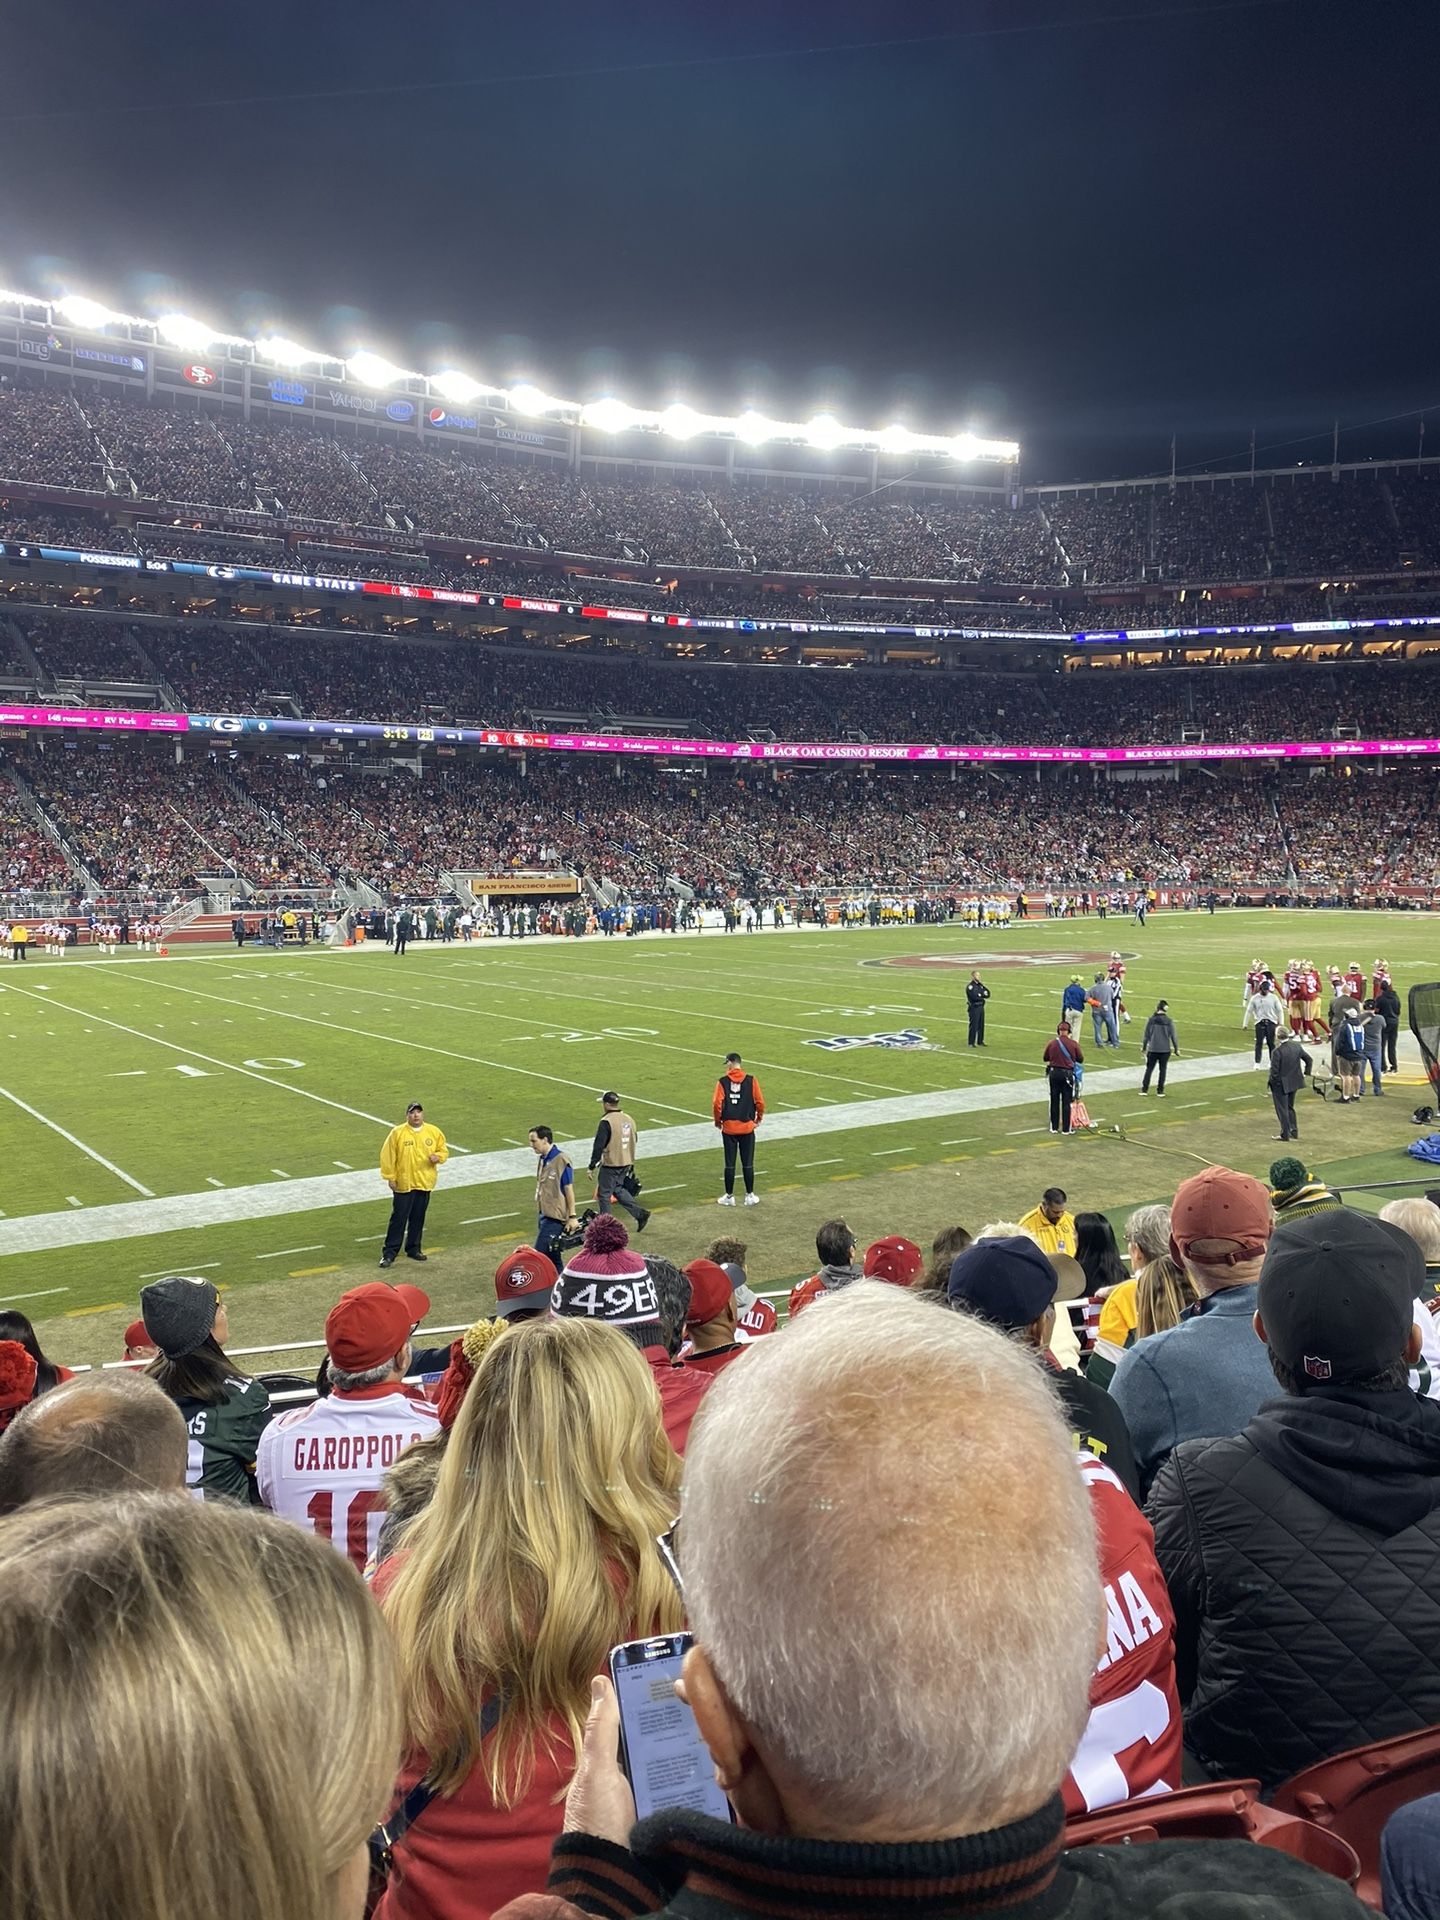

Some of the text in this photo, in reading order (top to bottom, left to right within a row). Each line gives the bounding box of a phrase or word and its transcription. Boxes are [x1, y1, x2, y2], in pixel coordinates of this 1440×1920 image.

[21, 339, 51, 360] nrg
[223, 514, 279, 529] SUPER
[283, 521, 329, 535] BOWL
[333, 528, 425, 547] CHAMPIONS
[80, 553, 168, 571] POSSESSION 5:04
[272, 573, 356, 592] GAME STATS
[432, 590, 478, 603] TURNOVERS
[521, 600, 559, 612] PENALTIES
[62, 715, 87, 723] rooms
[104, 717, 117, 725] RV
[119, 717, 137, 726] Park
[383, 727, 409, 740] 3:13
[486, 734, 499, 743] 10
[763, 747, 799, 757] BLACK
[801, 747, 825, 757] OAK
[826, 747, 867, 757] CASINO
[868, 748, 909, 757] RESORT
[1125, 750, 1153, 758] BLACK
[1174, 748, 1206, 757] CASINO
[1207, 747, 1241, 756] RESORT
[162, 1057, 306, 1078] 10
[569, 1277, 659, 1316] 49ER
[644, 1648, 671, 1658] SAMSUNG
